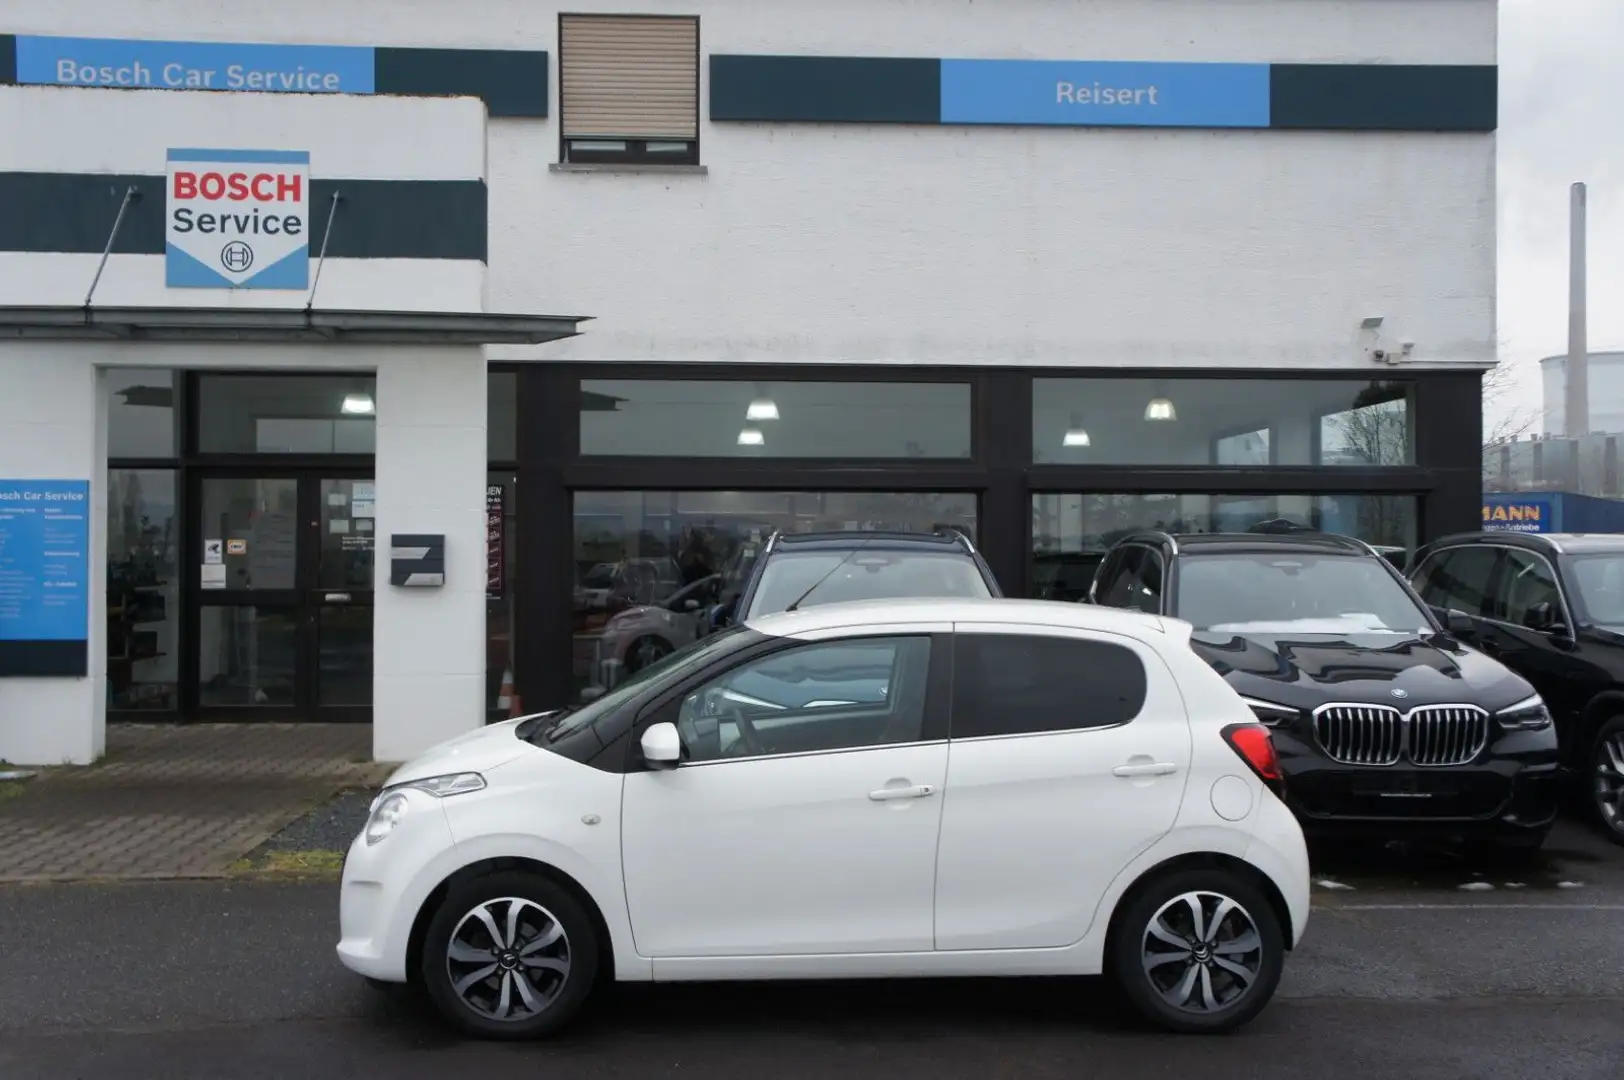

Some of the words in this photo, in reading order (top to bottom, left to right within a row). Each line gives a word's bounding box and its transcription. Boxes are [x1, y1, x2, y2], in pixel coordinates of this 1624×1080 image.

[56, 58, 151, 87] Bosch
[162, 63, 217, 88] Car
[226, 64, 341, 91] Service
[1057, 82, 1157, 105] Reisert
[173, 171, 302, 203] BOSCH
[172, 207, 302, 236] Service
[24, 490, 41, 502] Car
[44, 491, 84, 502] Service
